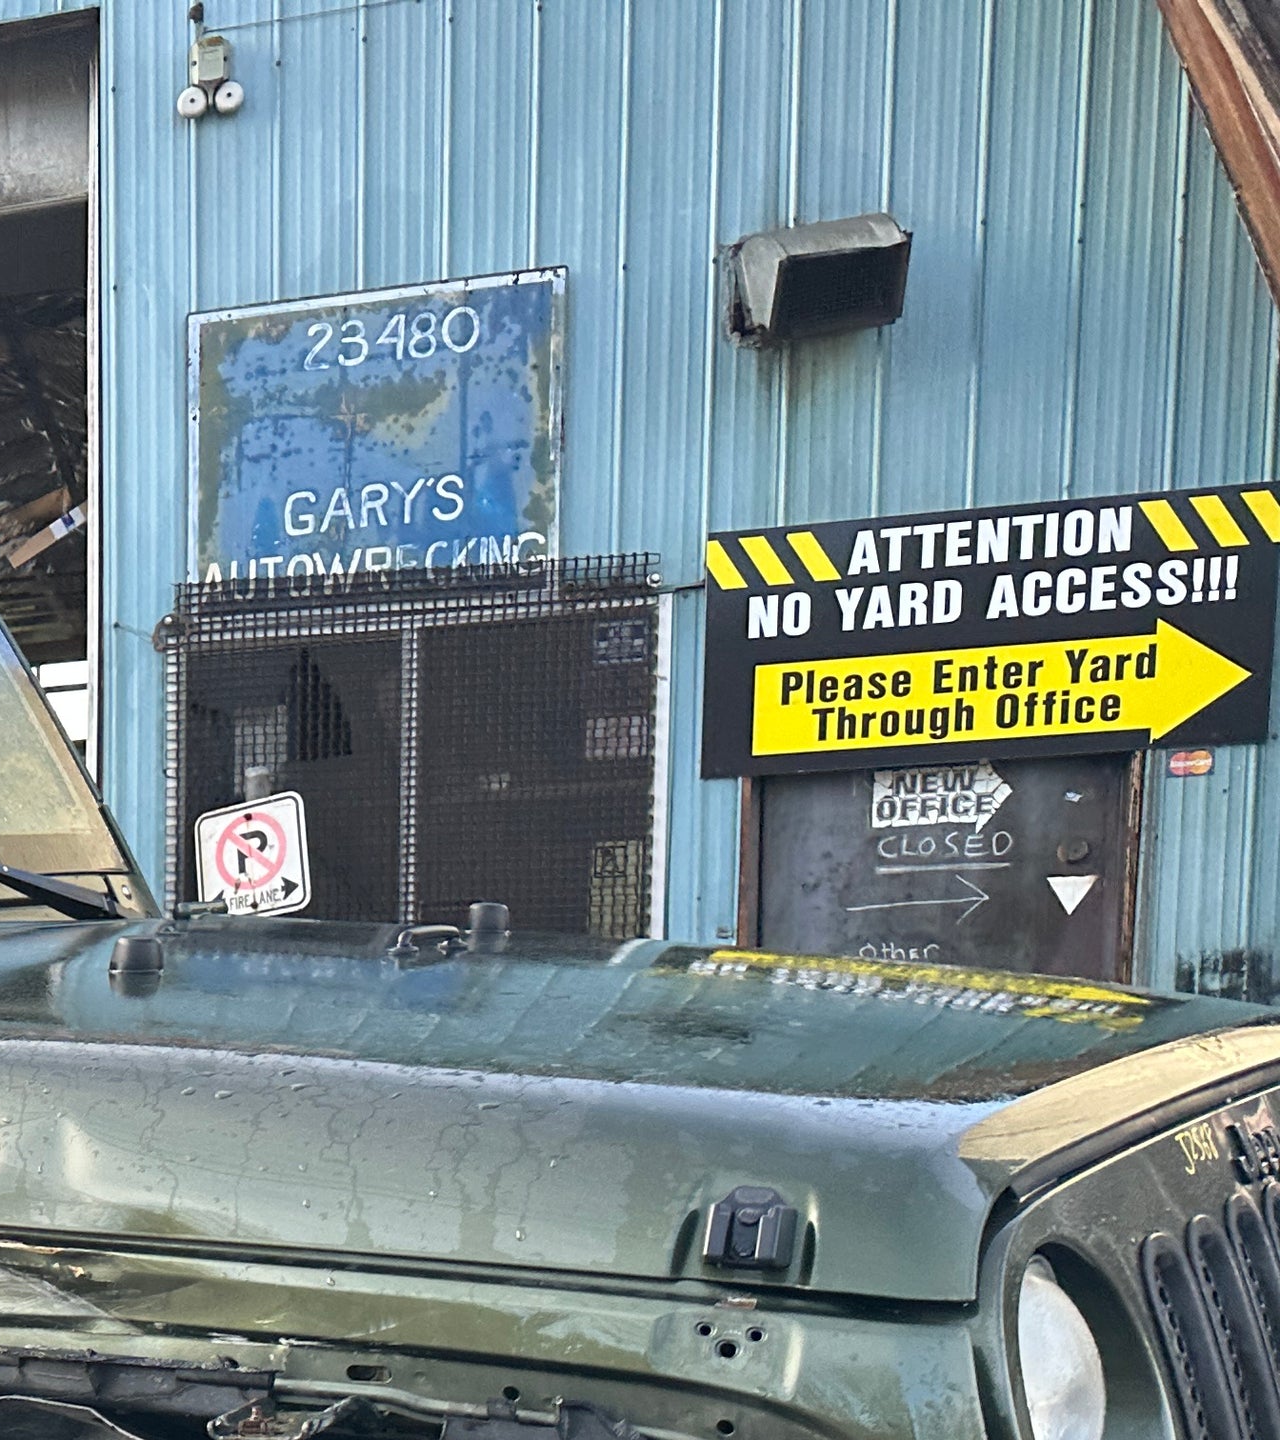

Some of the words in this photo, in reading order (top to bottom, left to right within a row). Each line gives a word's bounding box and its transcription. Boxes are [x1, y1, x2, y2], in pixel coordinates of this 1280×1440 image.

[303, 306, 480, 371] 23480
[284, 474, 465, 536] GARY'S
[847, 506, 1134, 576] ATTENTION
[747, 592, 812, 640] NO
[833, 579, 963, 632] YARD
[986, 554, 1240, 622] ACCESS!!!
[781, 670, 912, 706] Please
[933, 655, 1044, 695] Enter
[1065, 643, 1158, 684] Yard
[812, 697, 974, 741] Through
[995, 689, 1121, 729] Office
[876, 792, 993, 822] OFFICE
[893, 771, 975, 796] NEW
[878, 831, 1013, 858] CLOSED
[229, 894, 252, 911] FIRE
